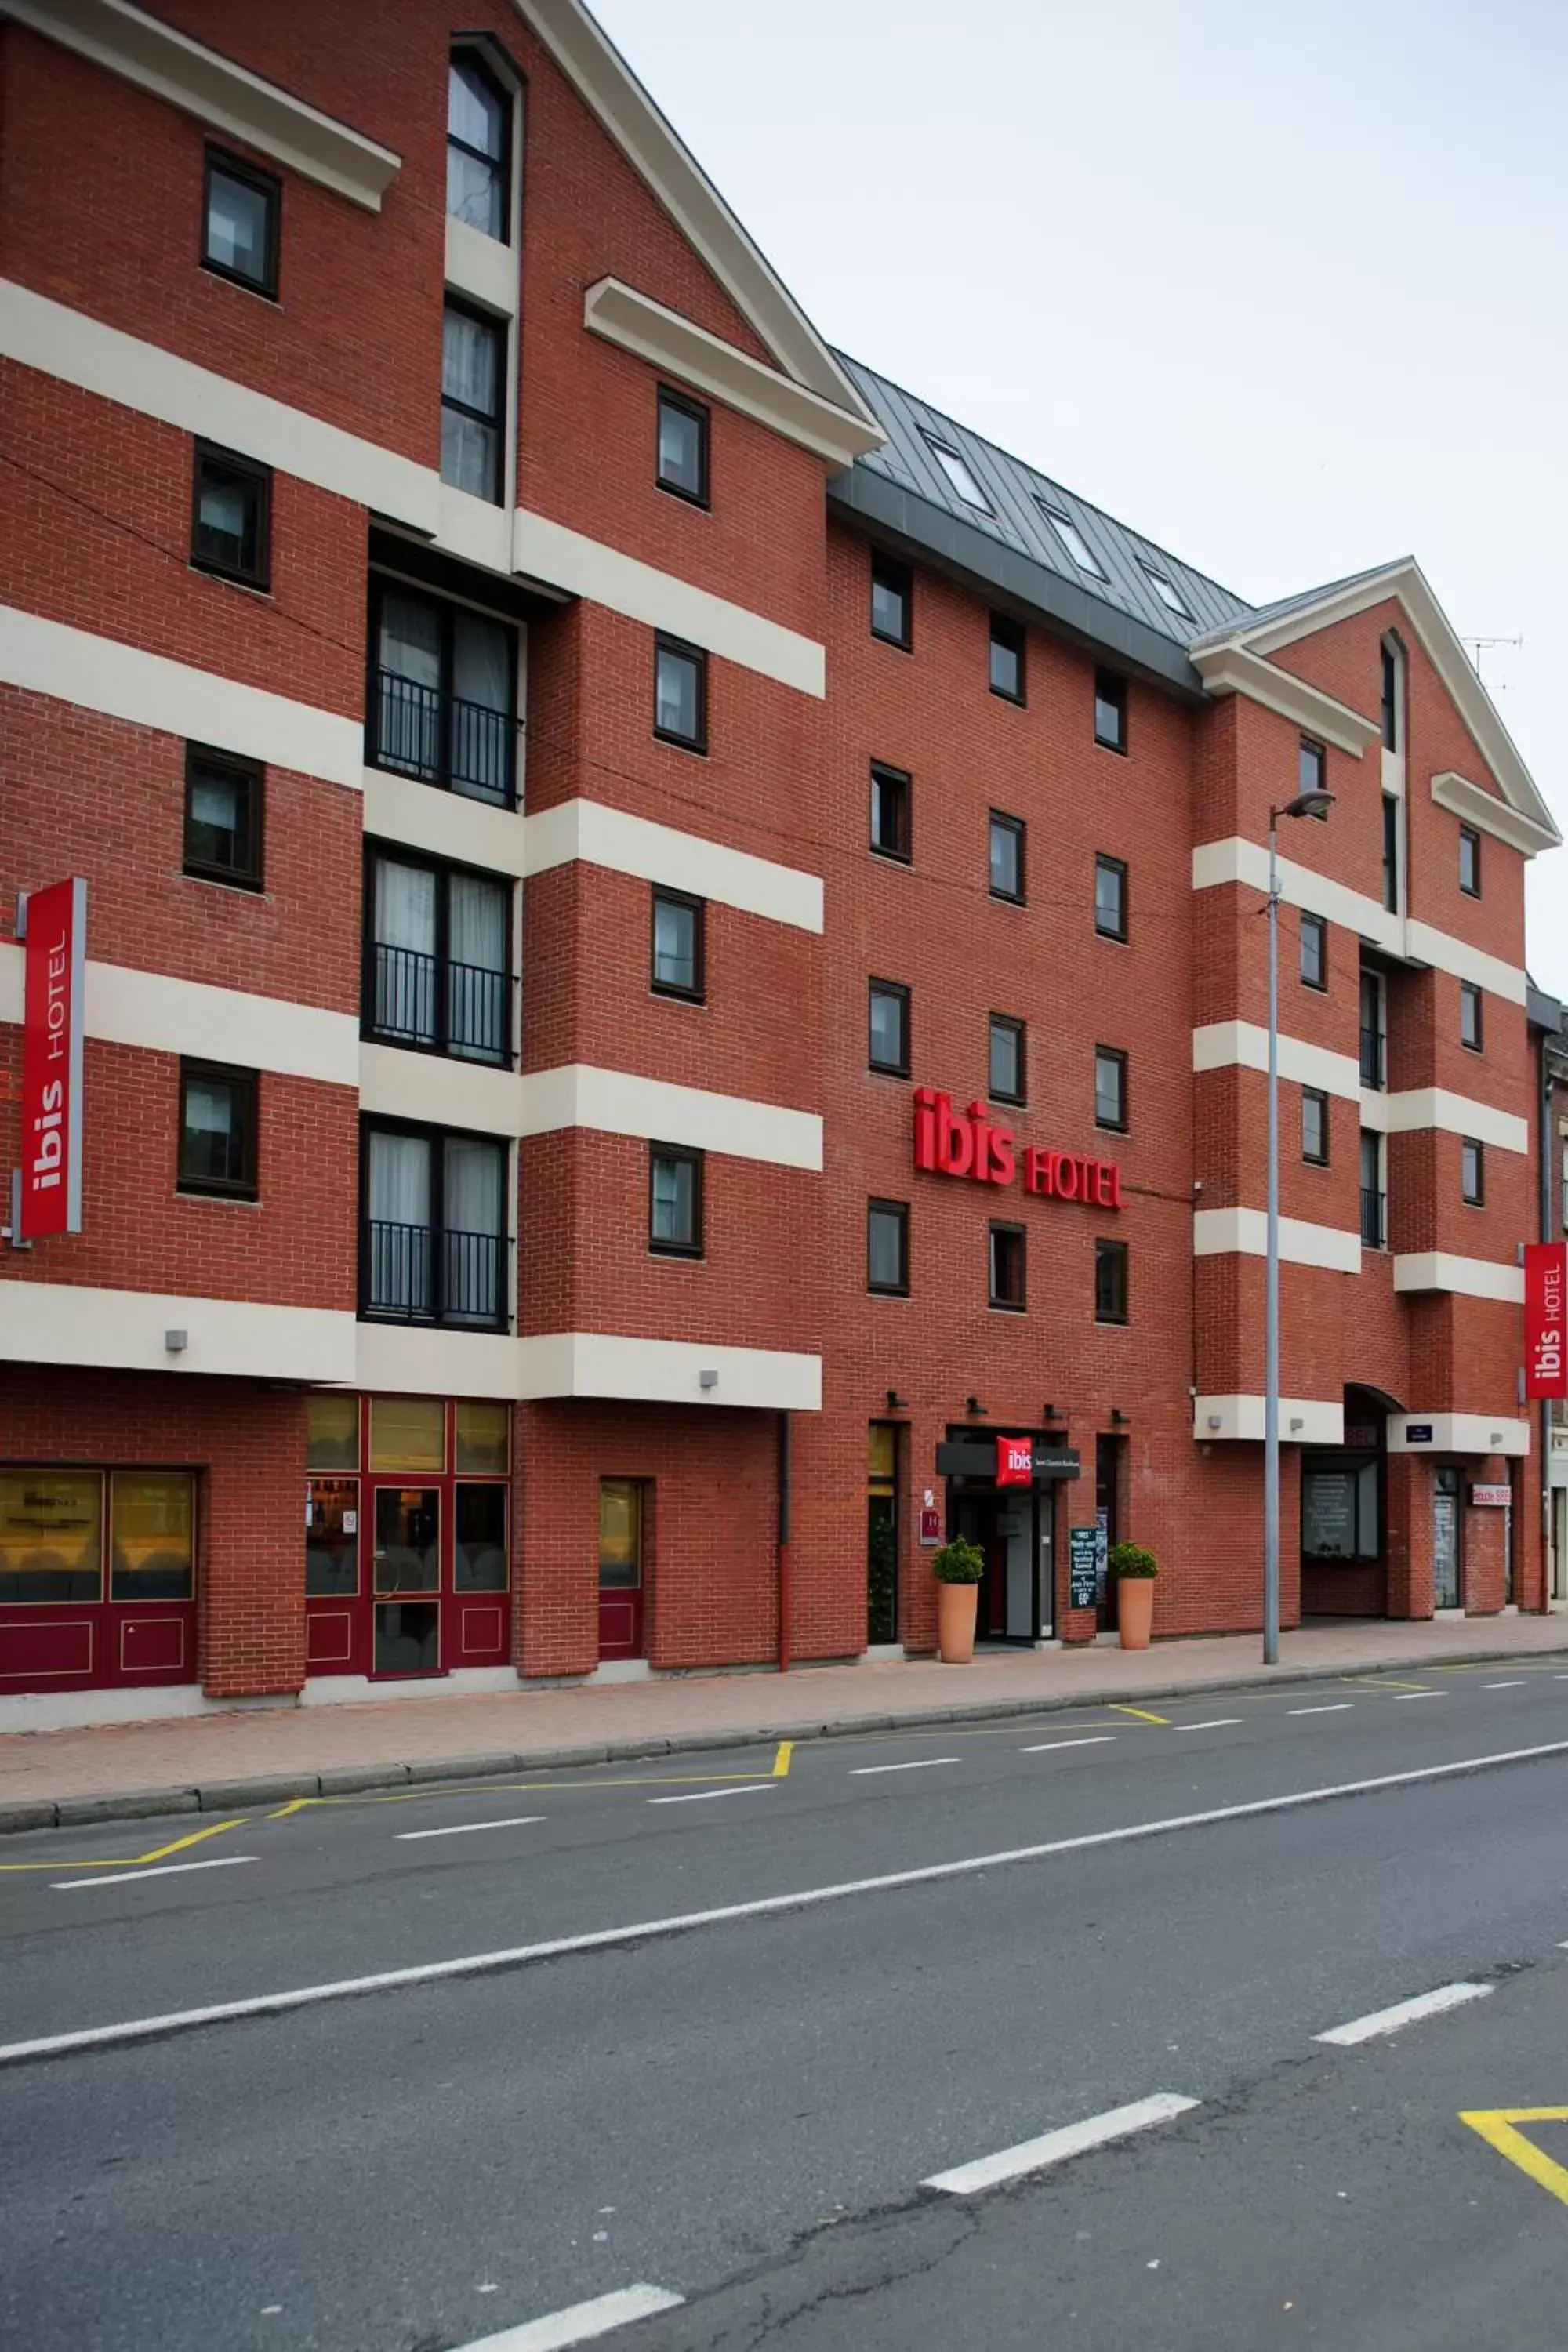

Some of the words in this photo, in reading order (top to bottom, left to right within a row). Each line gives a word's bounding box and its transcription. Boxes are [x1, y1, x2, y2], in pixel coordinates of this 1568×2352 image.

[47, 929, 66, 1060] HOTEL
[33, 1080, 63, 1189] ibis
[914, 1087, 1016, 1185] ibis
[1025, 1145, 1130, 1209] HOTEL
[1544, 1264, 1561, 1321] HOTEL
[1535, 1329, 1560, 1378] ibis
[1008, 1449, 1032, 1470] ibis
